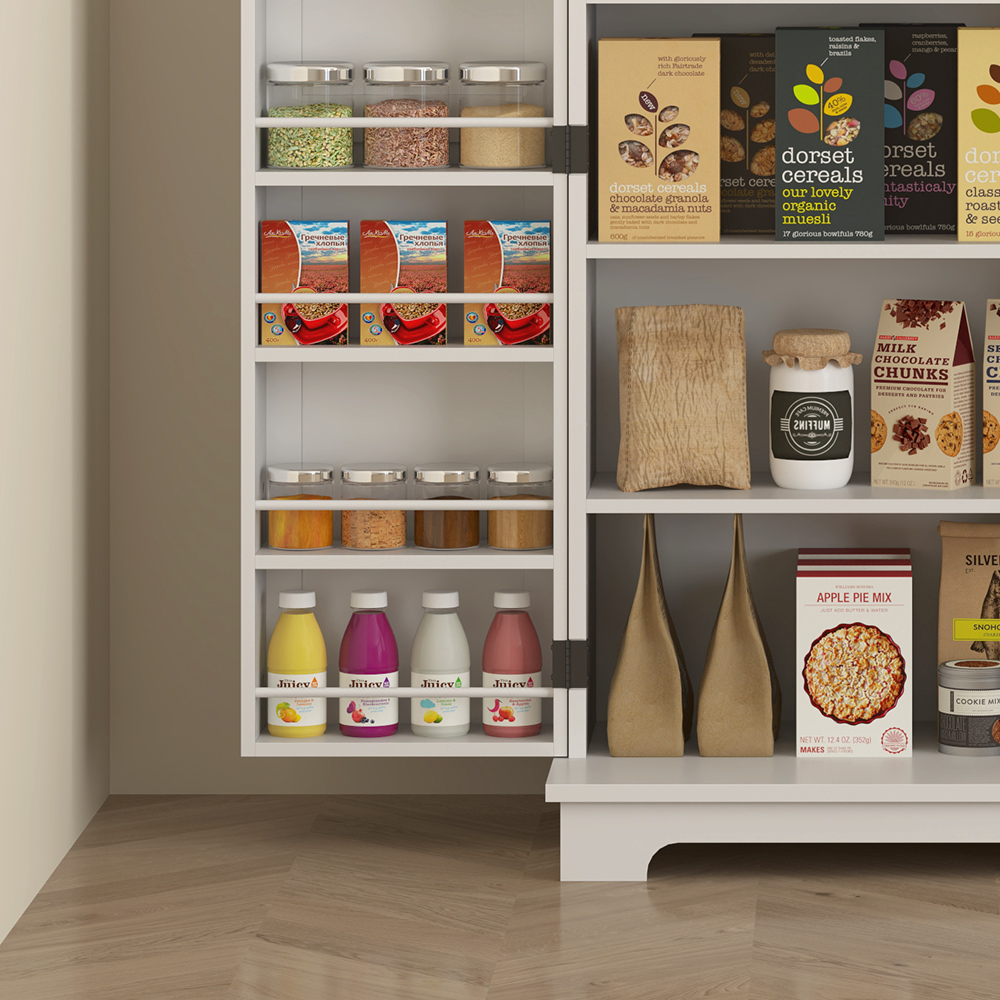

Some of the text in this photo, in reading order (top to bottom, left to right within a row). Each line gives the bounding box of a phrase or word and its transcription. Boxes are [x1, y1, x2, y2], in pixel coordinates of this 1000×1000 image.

[641, 94, 656, 110] new
[733, 90, 747, 105] new
[781, 147, 854, 164] dorset
[884, 142, 937, 158] orset
[781, 166, 863, 183] cereals
[884, 161, 945, 178] ereals
[609, 182, 706, 193] dorset cereals
[720, 177, 775, 187] rset cere
[782, 186, 853, 200] our lovely
[884, 181, 956, 195] ntasticaly
[609, 194, 709, 204] chocolate granola
[609, 204, 620, 213] &
[622, 204, 685, 213] macadamia
[688, 204, 712, 213] nuts
[782, 200, 836, 213] organic
[782, 213, 831, 224] muesli
[965, 213, 978, 224] &
[610, 233, 628, 241] 600g
[792, 230, 821, 238] glorious
[876, 343, 917, 353] MILK
[874, 355, 950, 366] CHOCOLATE
[873, 366, 948, 380] CHUNKS
[816, 592, 892, 603] APPLE PIE MIX
